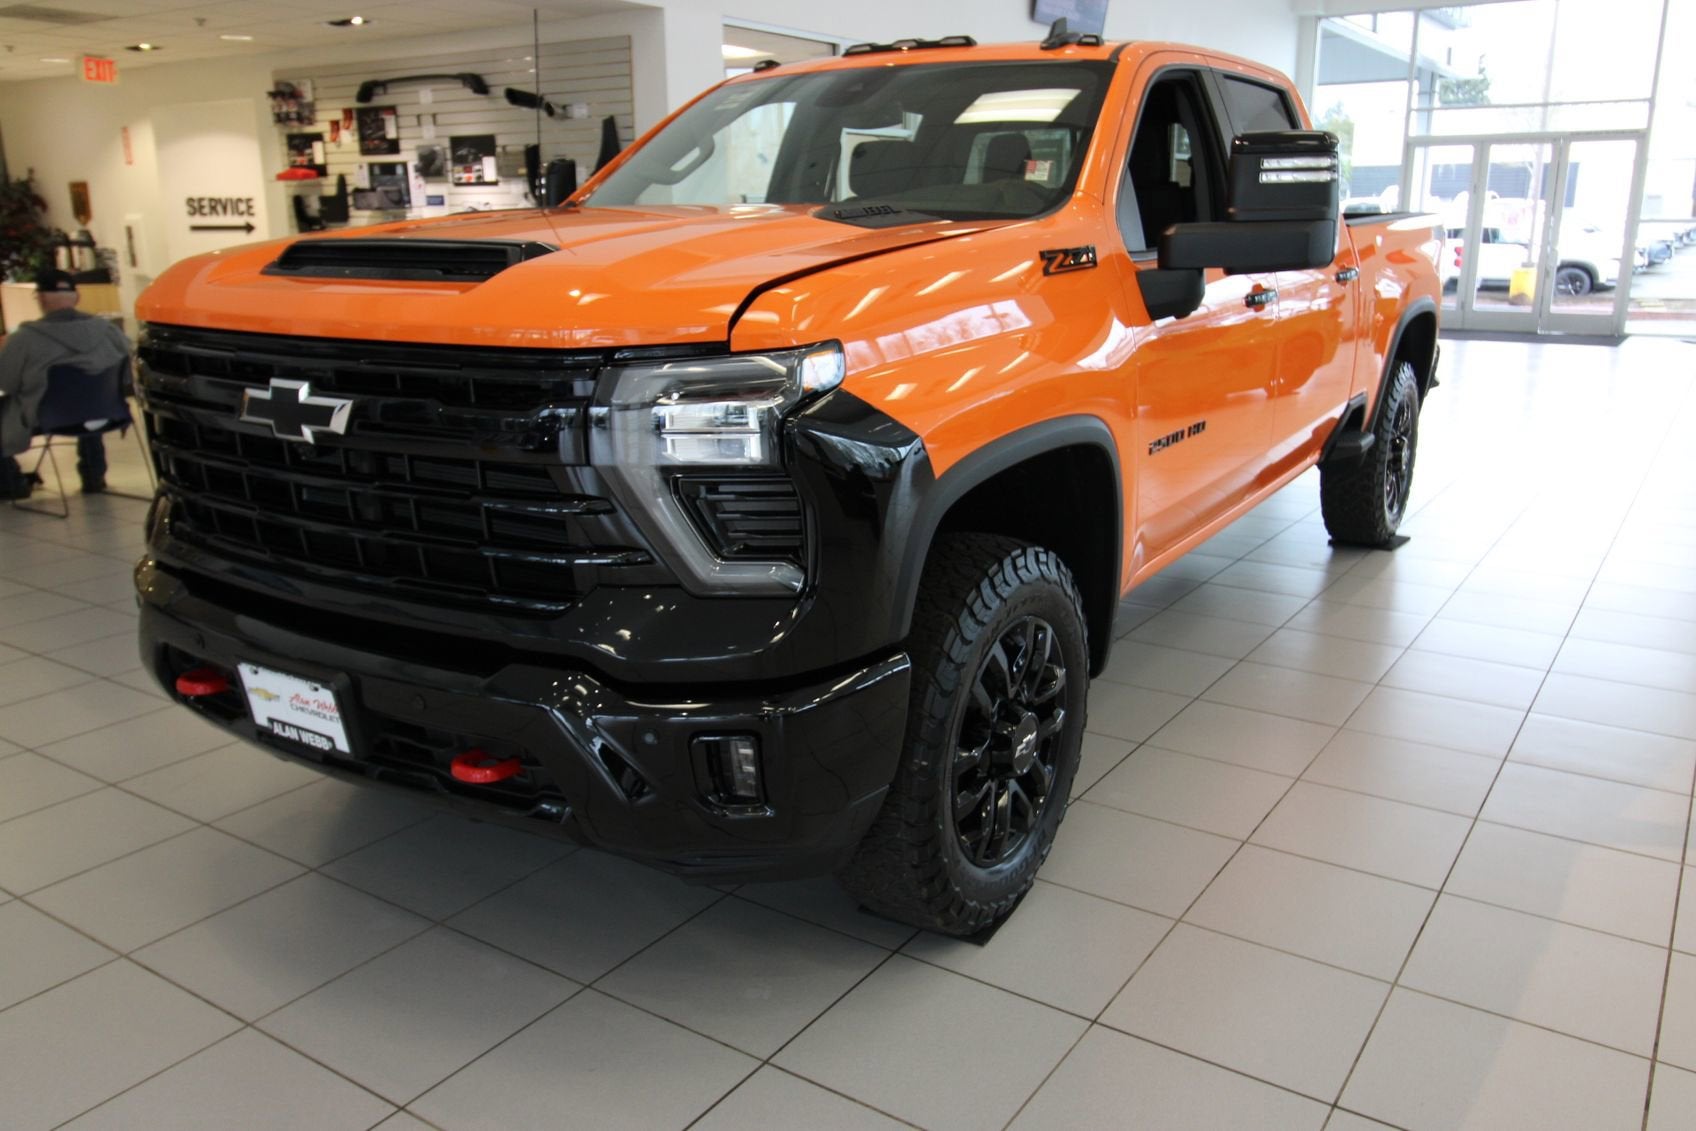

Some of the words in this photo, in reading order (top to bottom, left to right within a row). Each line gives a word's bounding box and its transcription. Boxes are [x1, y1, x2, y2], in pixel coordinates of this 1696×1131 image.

[84, 57, 114, 82] EXIT
[186, 197, 255, 216] SERVICE
[1148, 428, 1185, 456] 2500
[1187, 420, 1206, 438] HD
[290, 703, 340, 723] CHEVROLET
[273, 721, 300, 741] ALAN
[300, 729, 332, 750] WEBB
